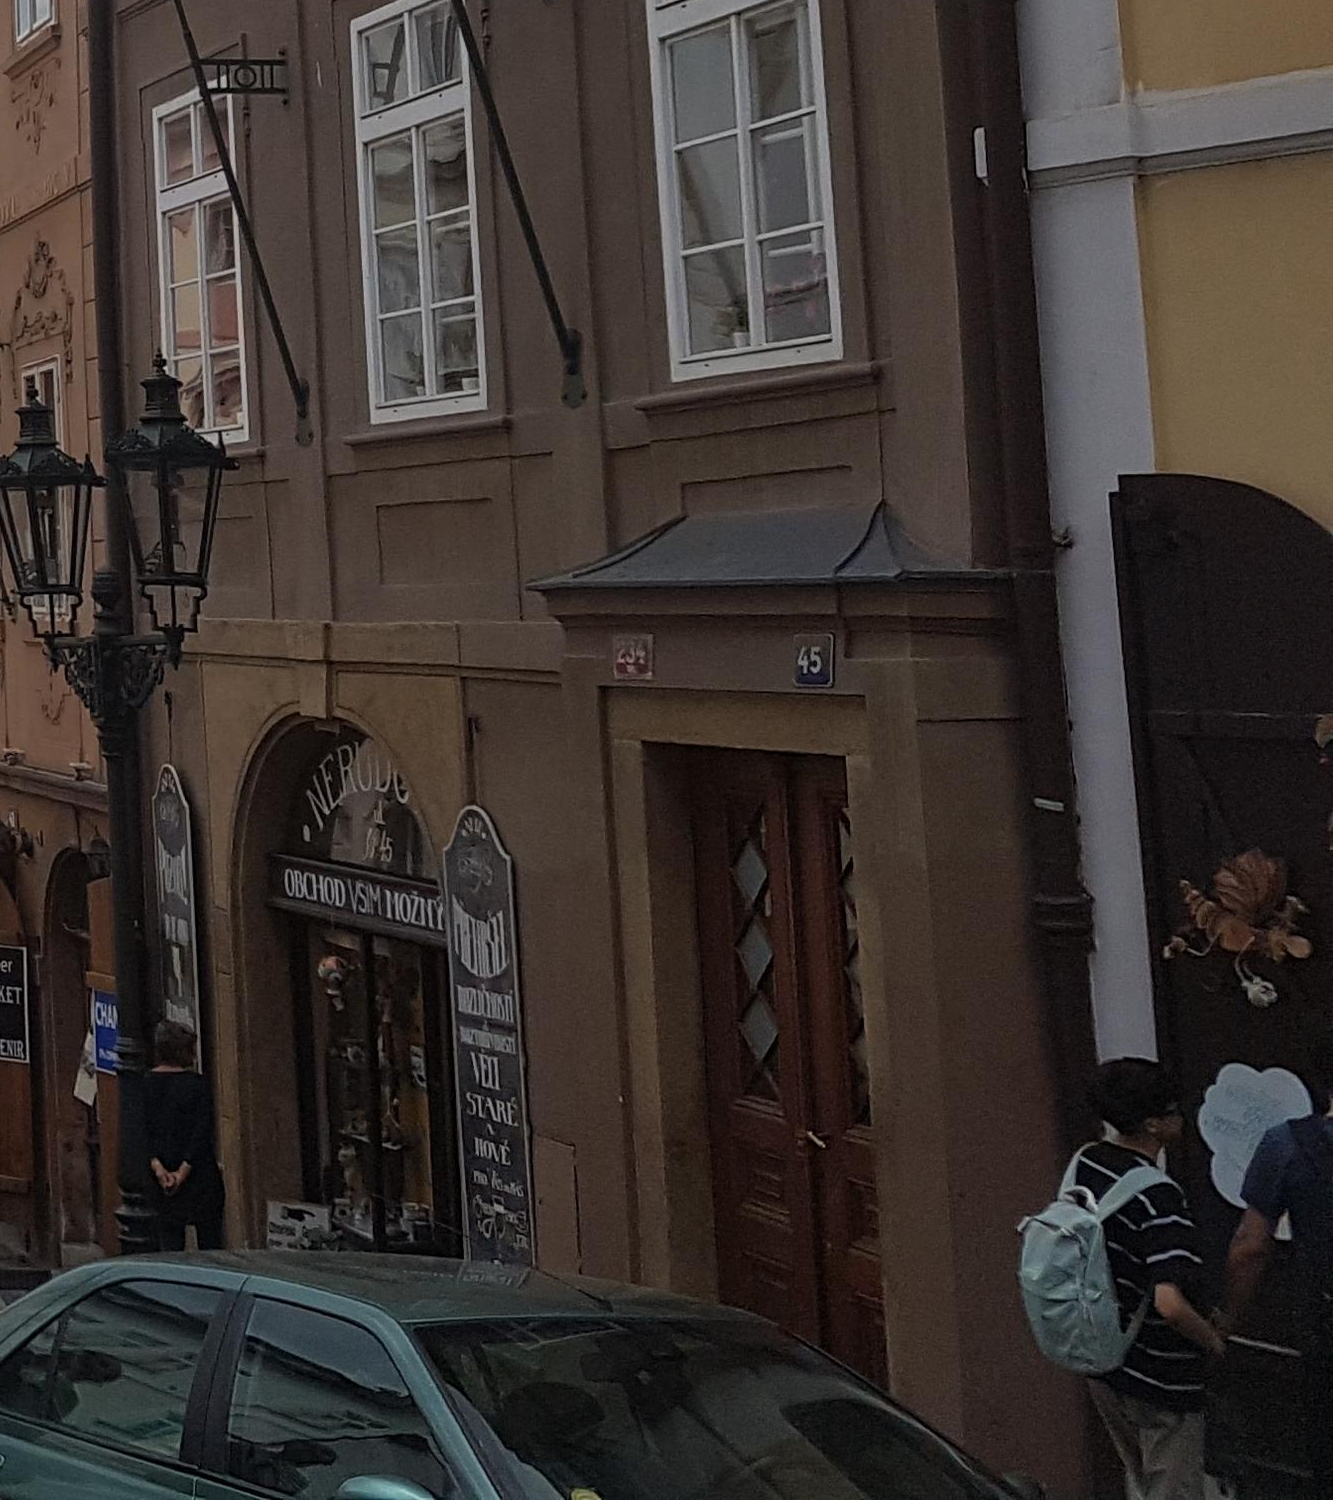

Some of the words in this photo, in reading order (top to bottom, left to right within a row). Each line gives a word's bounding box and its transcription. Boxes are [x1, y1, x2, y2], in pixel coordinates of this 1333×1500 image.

[797, 646, 822, 674] 45
[284, 868, 346, 908] OBCHOD
[385, 889, 446, 931] MOŽNÝ
[465, 1091, 519, 1127] STARÉ
[474, 1136, 512, 1166] NOVÉ
